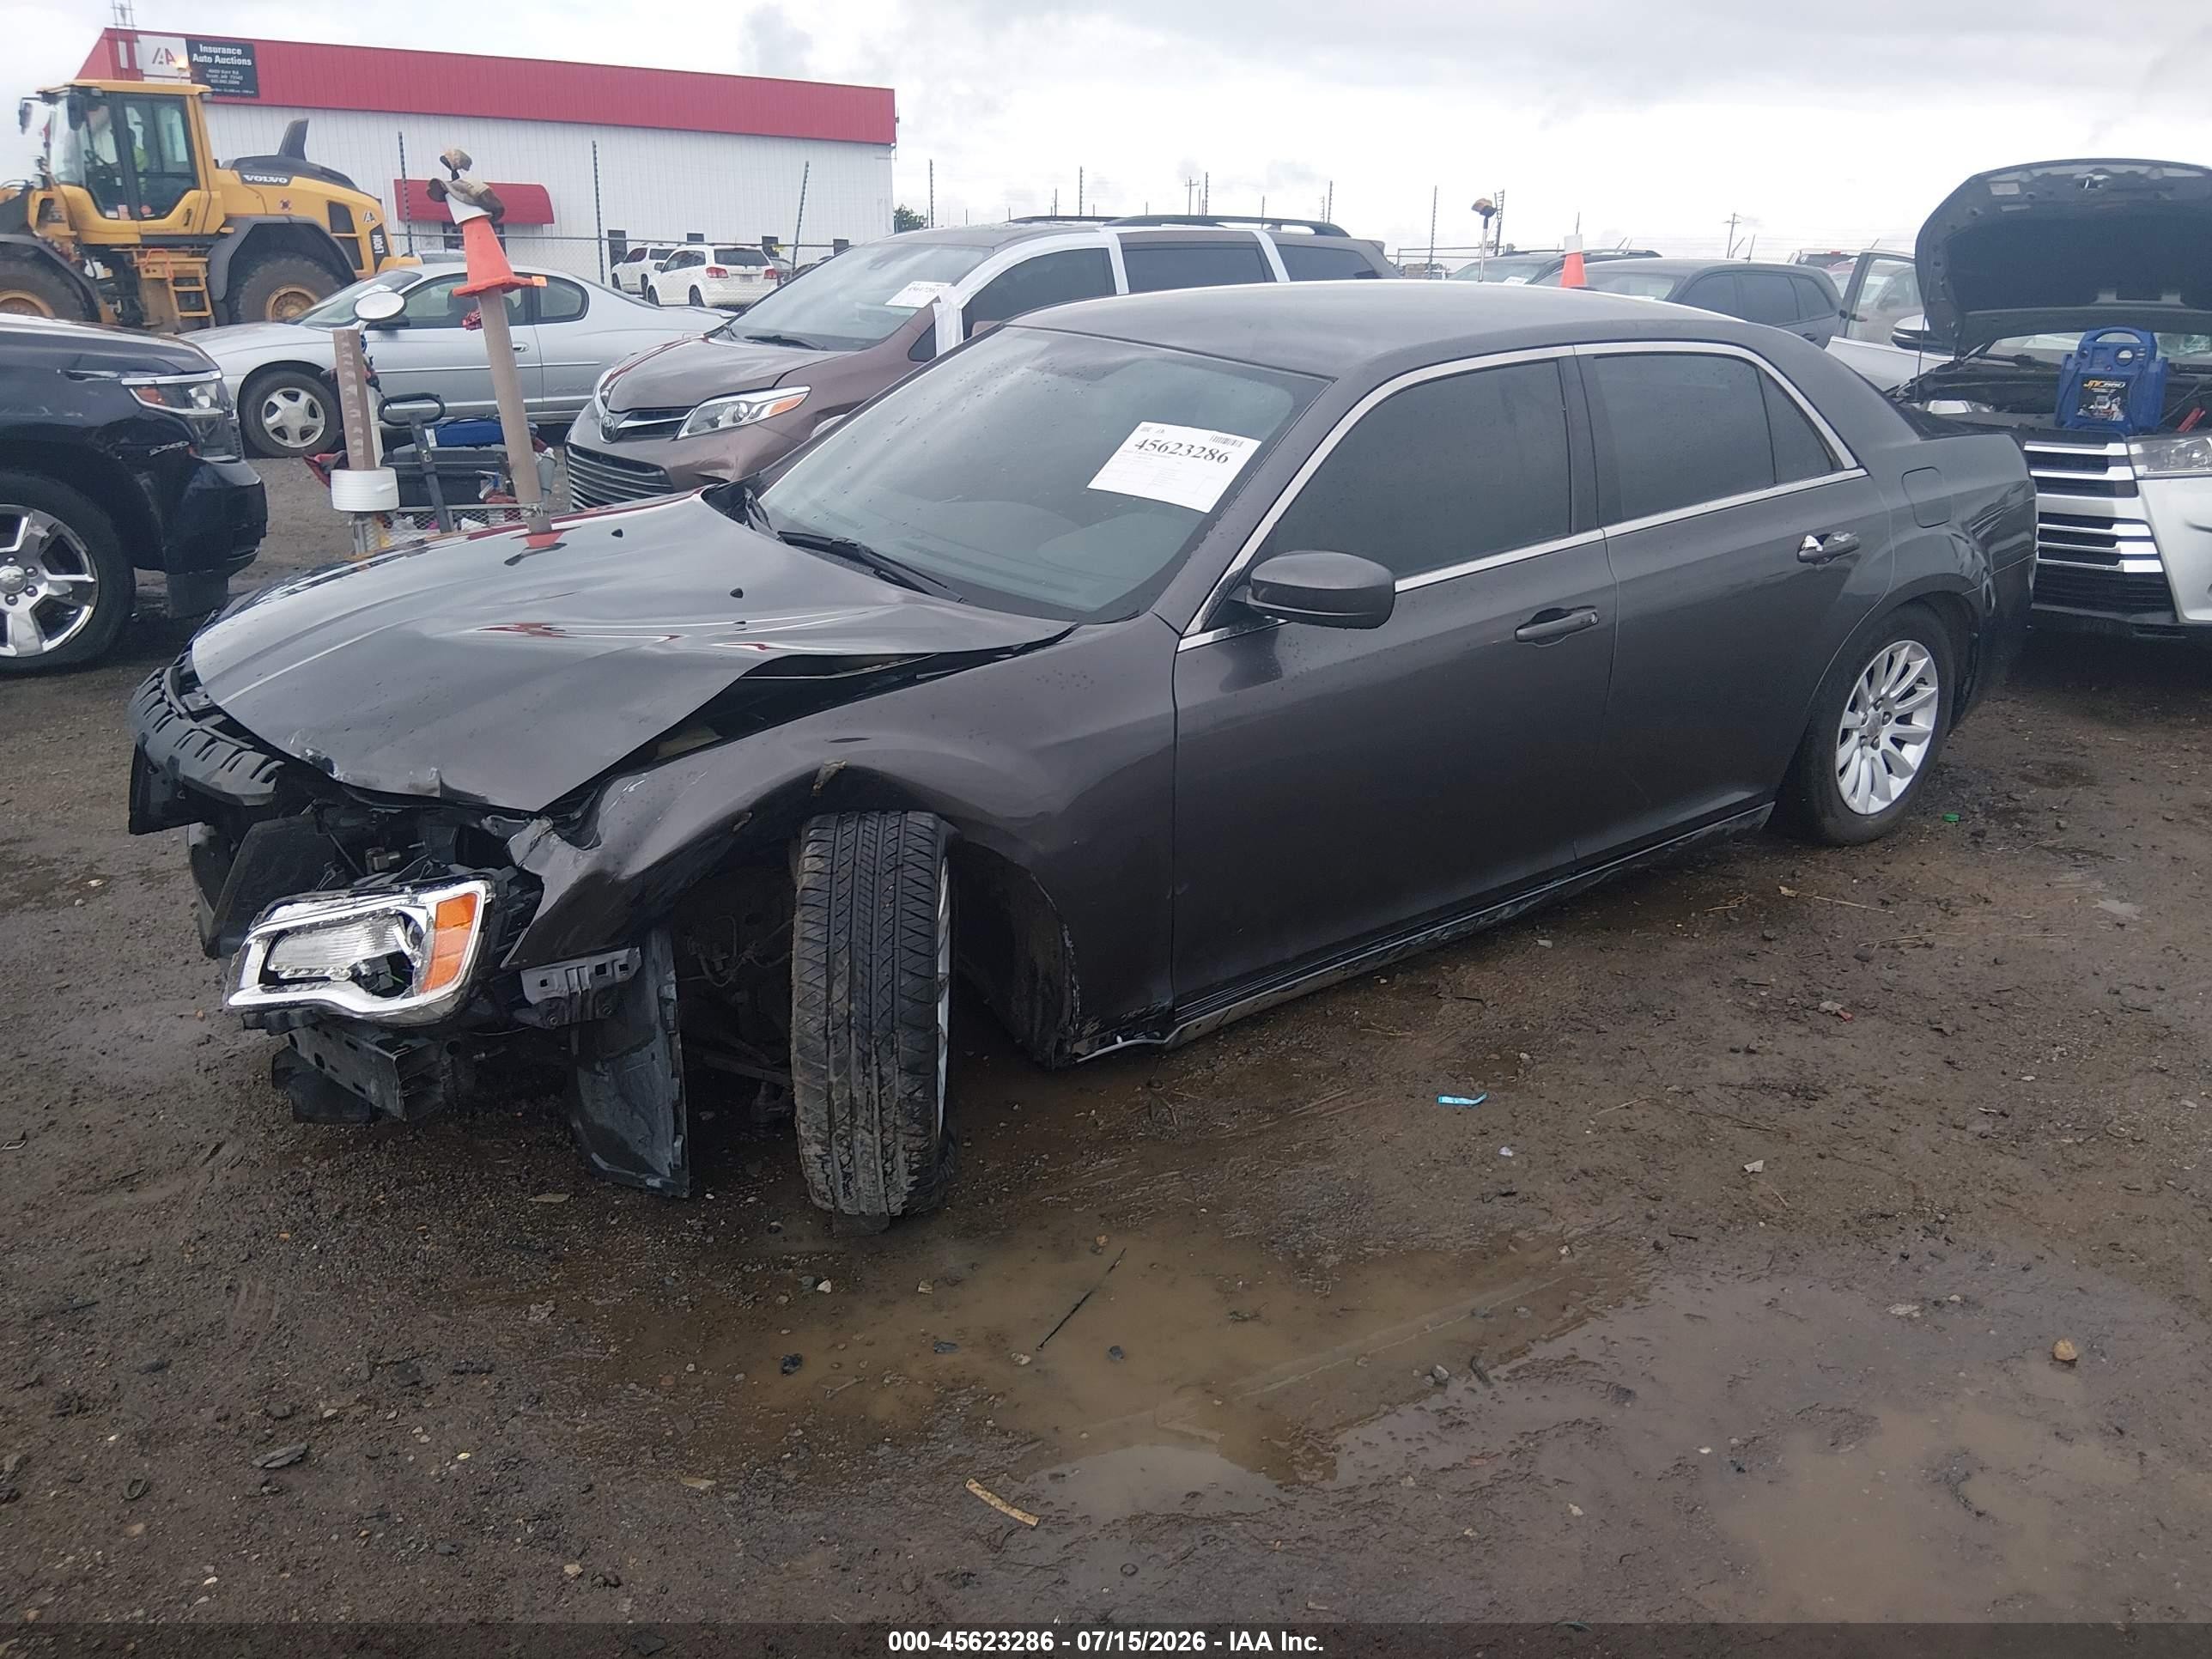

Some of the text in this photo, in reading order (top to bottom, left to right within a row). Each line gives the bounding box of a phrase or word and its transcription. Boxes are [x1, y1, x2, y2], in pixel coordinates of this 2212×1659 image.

[199, 44, 242, 55] Insurance
[192, 53, 252, 66] Auto Auctions
[242, 174, 289, 184] VOLVO
[1134, 438, 1234, 465] 45623286
